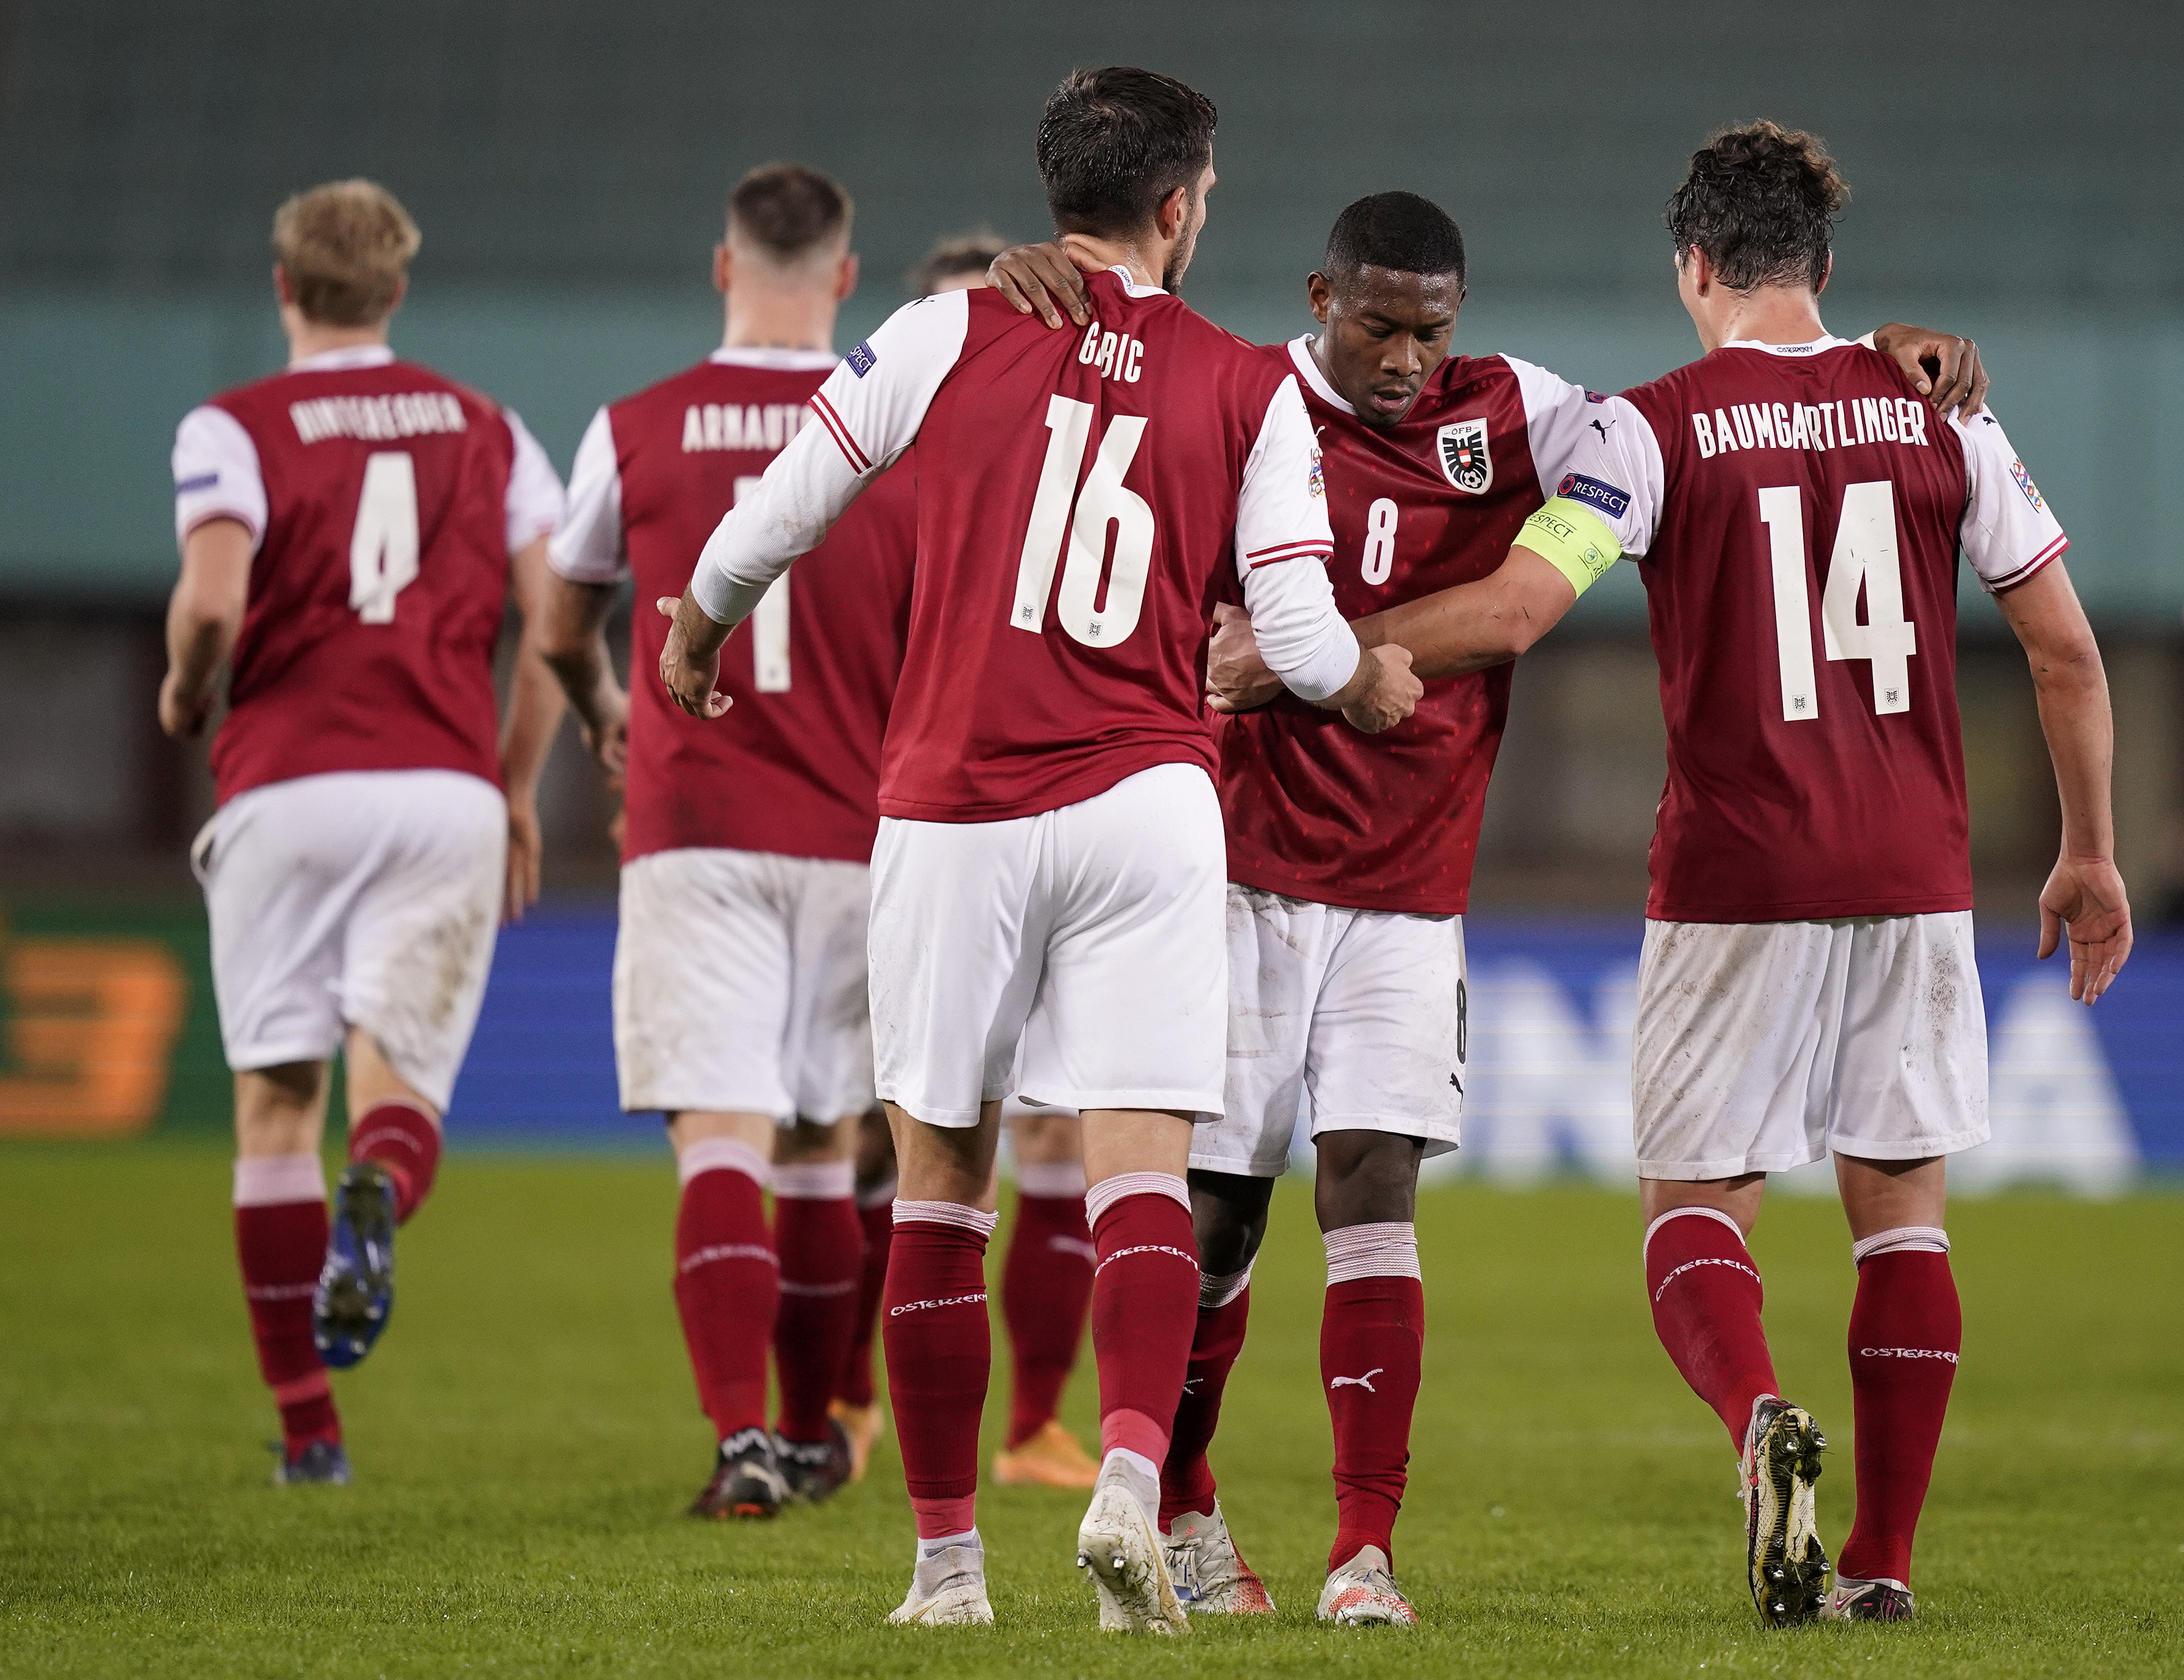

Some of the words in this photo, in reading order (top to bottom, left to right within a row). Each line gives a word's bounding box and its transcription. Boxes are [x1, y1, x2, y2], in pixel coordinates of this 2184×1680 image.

[850, 346, 872, 371] SPECT
[1692, 397, 1929, 459] BAUMGARTLINGER
[349, 451, 420, 624] 4
[1010, 394, 1155, 648] 16
[1527, 514, 1573, 537] ESPECT
[1573, 482, 1627, 511] RESPECT
[1361, 498, 1399, 585] 8
[1758, 480, 1916, 721] 14
[1457, 978, 1466, 1064] 8
